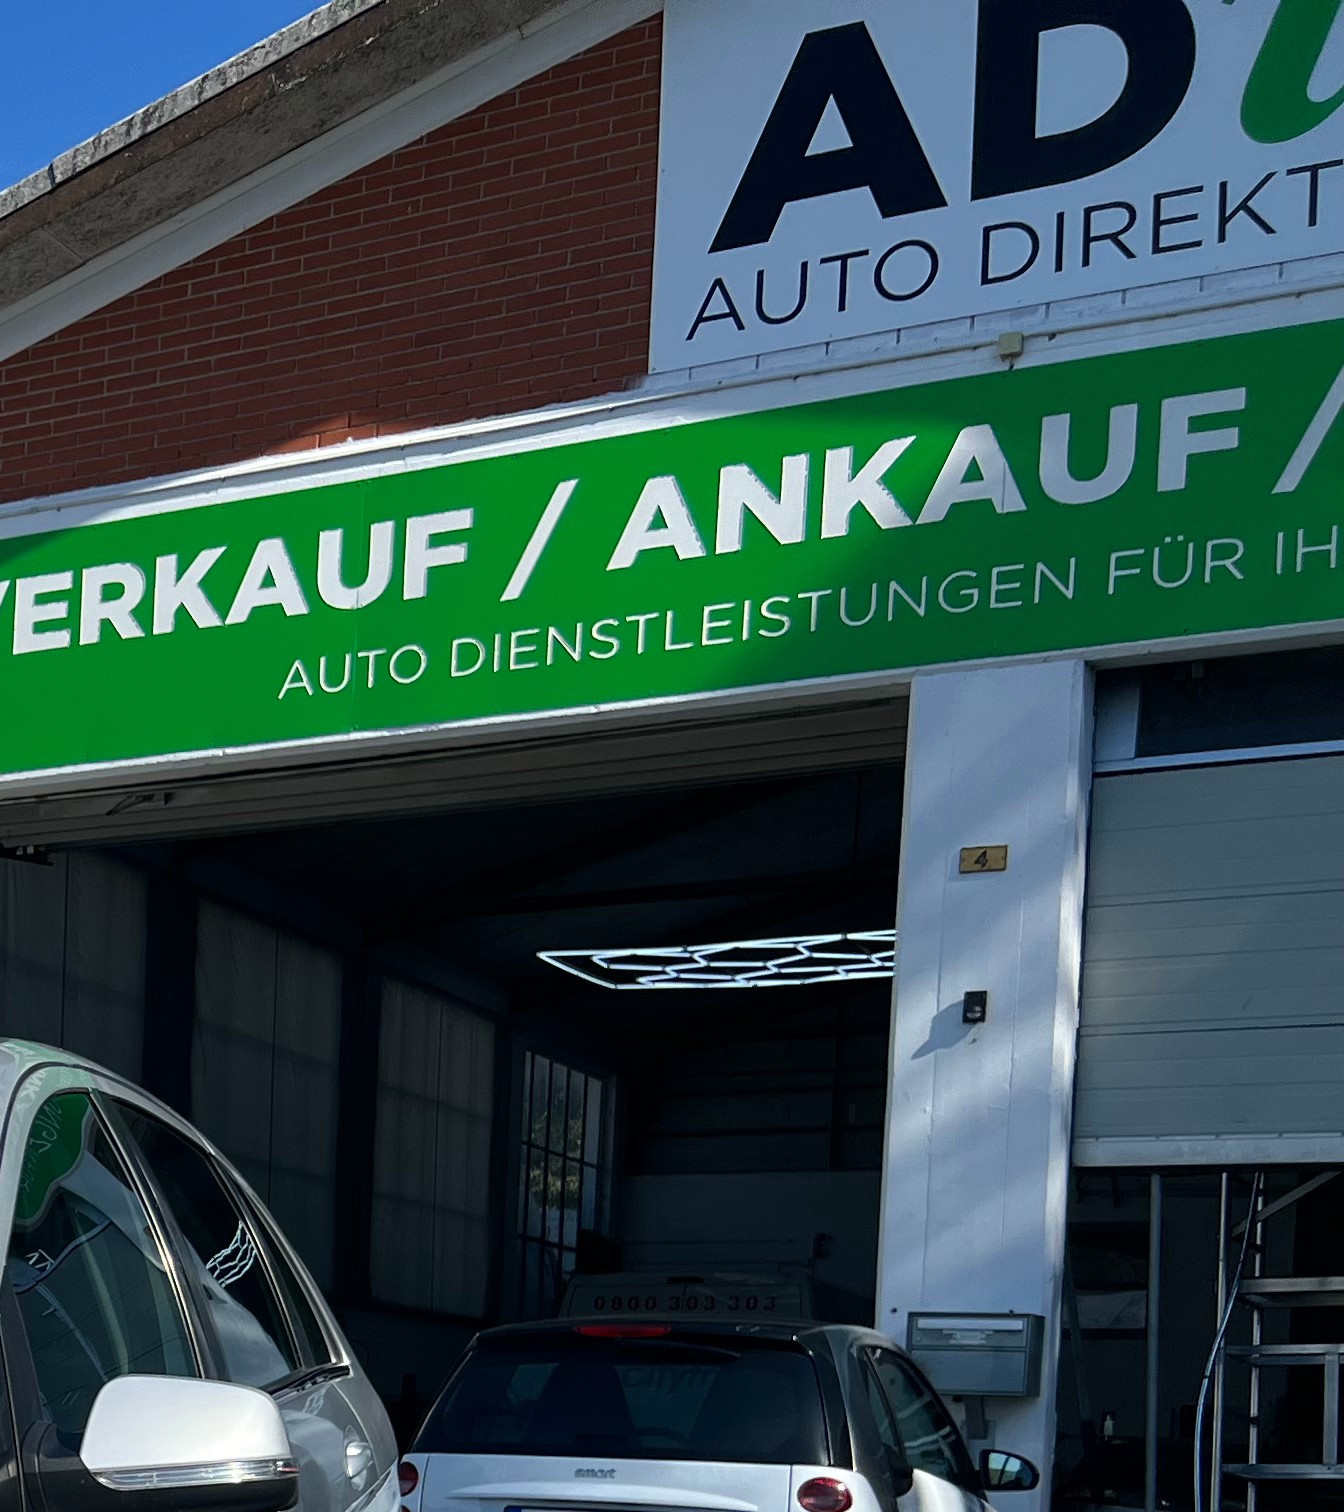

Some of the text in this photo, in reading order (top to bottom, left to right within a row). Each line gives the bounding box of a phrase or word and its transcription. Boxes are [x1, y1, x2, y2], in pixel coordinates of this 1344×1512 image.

[685, 158, 1344, 342] AUTO DIREKT
[606, 387, 1247, 572] ANKAUF
[278, 644, 429, 700] AUTO
[450, 556, 1077, 679] DIENSTLEISTUNGEN
[1108, 535, 1245, 596] FÜR
[974, 849, 988, 868] 4
[593, 1295, 657, 1312] 0800
